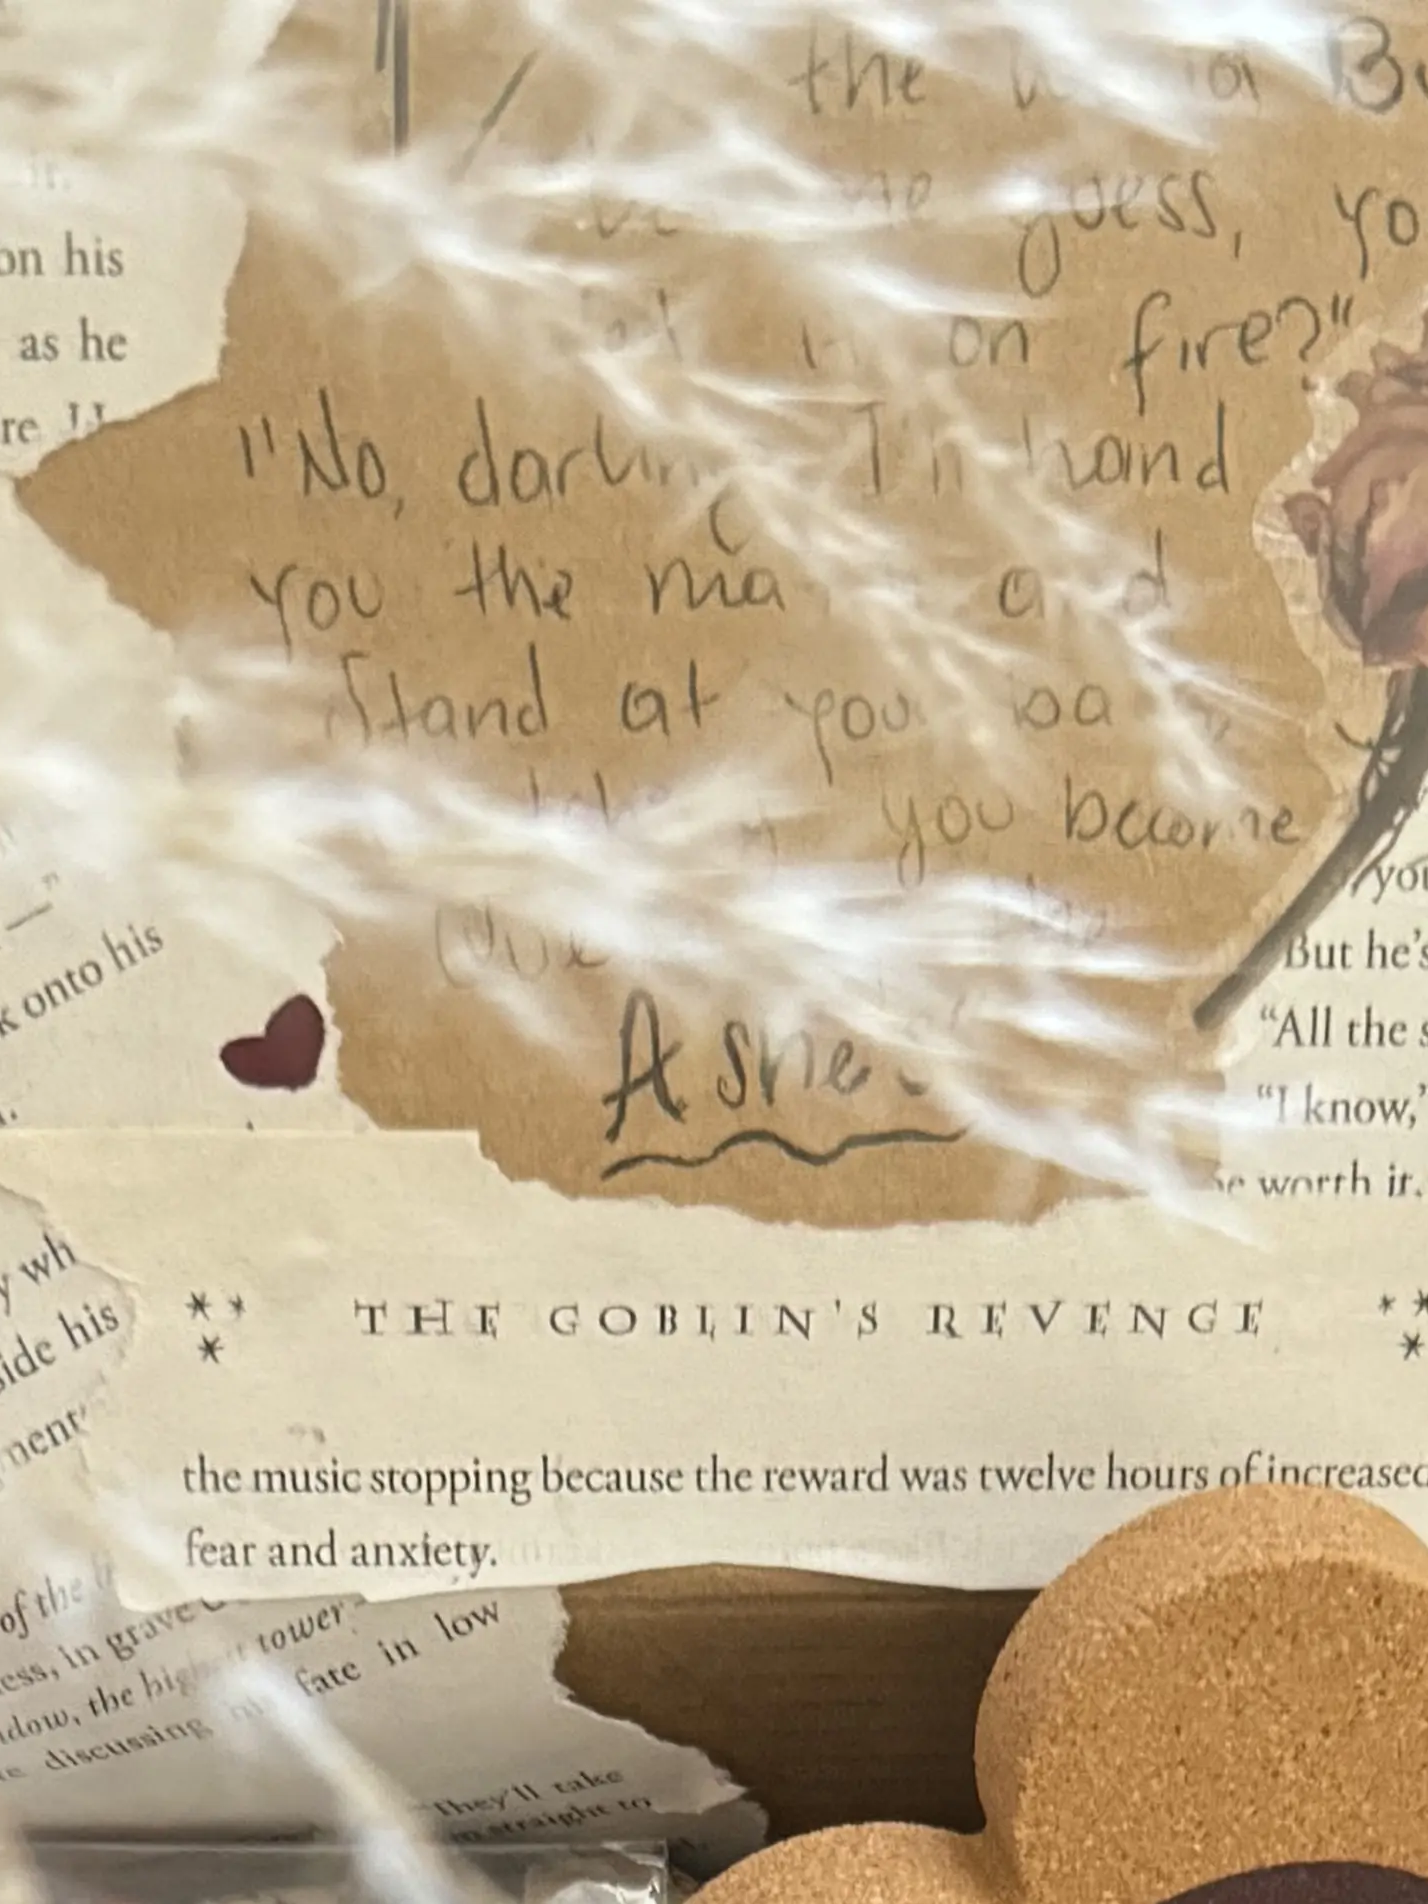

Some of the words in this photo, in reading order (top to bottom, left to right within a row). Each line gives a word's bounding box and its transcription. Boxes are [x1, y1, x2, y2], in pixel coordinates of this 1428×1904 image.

[787, 19, 925, 113] the
[62, 228, 126, 279] his
[17, 331, 60, 363] as
[77, 313, 128, 363] he
[948, 318, 1030, 368] on
[250, 562, 385, 660] you
[457, 549, 573, 620] the
[998, 531, 1171, 620] ad
[618, 657, 721, 734] at
[352, 1297, 502, 1341] THE
[547, 1296, 880, 1342] GOBLIN'S
[929, 1297, 1264, 1340] REVENGE
[180, 1450, 242, 1495] the
[250, 1455, 363, 1495] music
[367, 1454, 533, 1508] stopping
[539, 1451, 685, 1495] because
[693, 1451, 753, 1494] the
[762, 1449, 890, 1493] reward
[897, 1465, 968, 1494] was
[977, 1448, 1097, 1493] twelve
[1104, 1448, 1209, 1492] hours
[1217, 1447, 1263, 1489] of
[185, 1524, 258, 1568] fear
[266, 1525, 339, 1568] and
[349, 1529, 498, 1580] anxiety.
